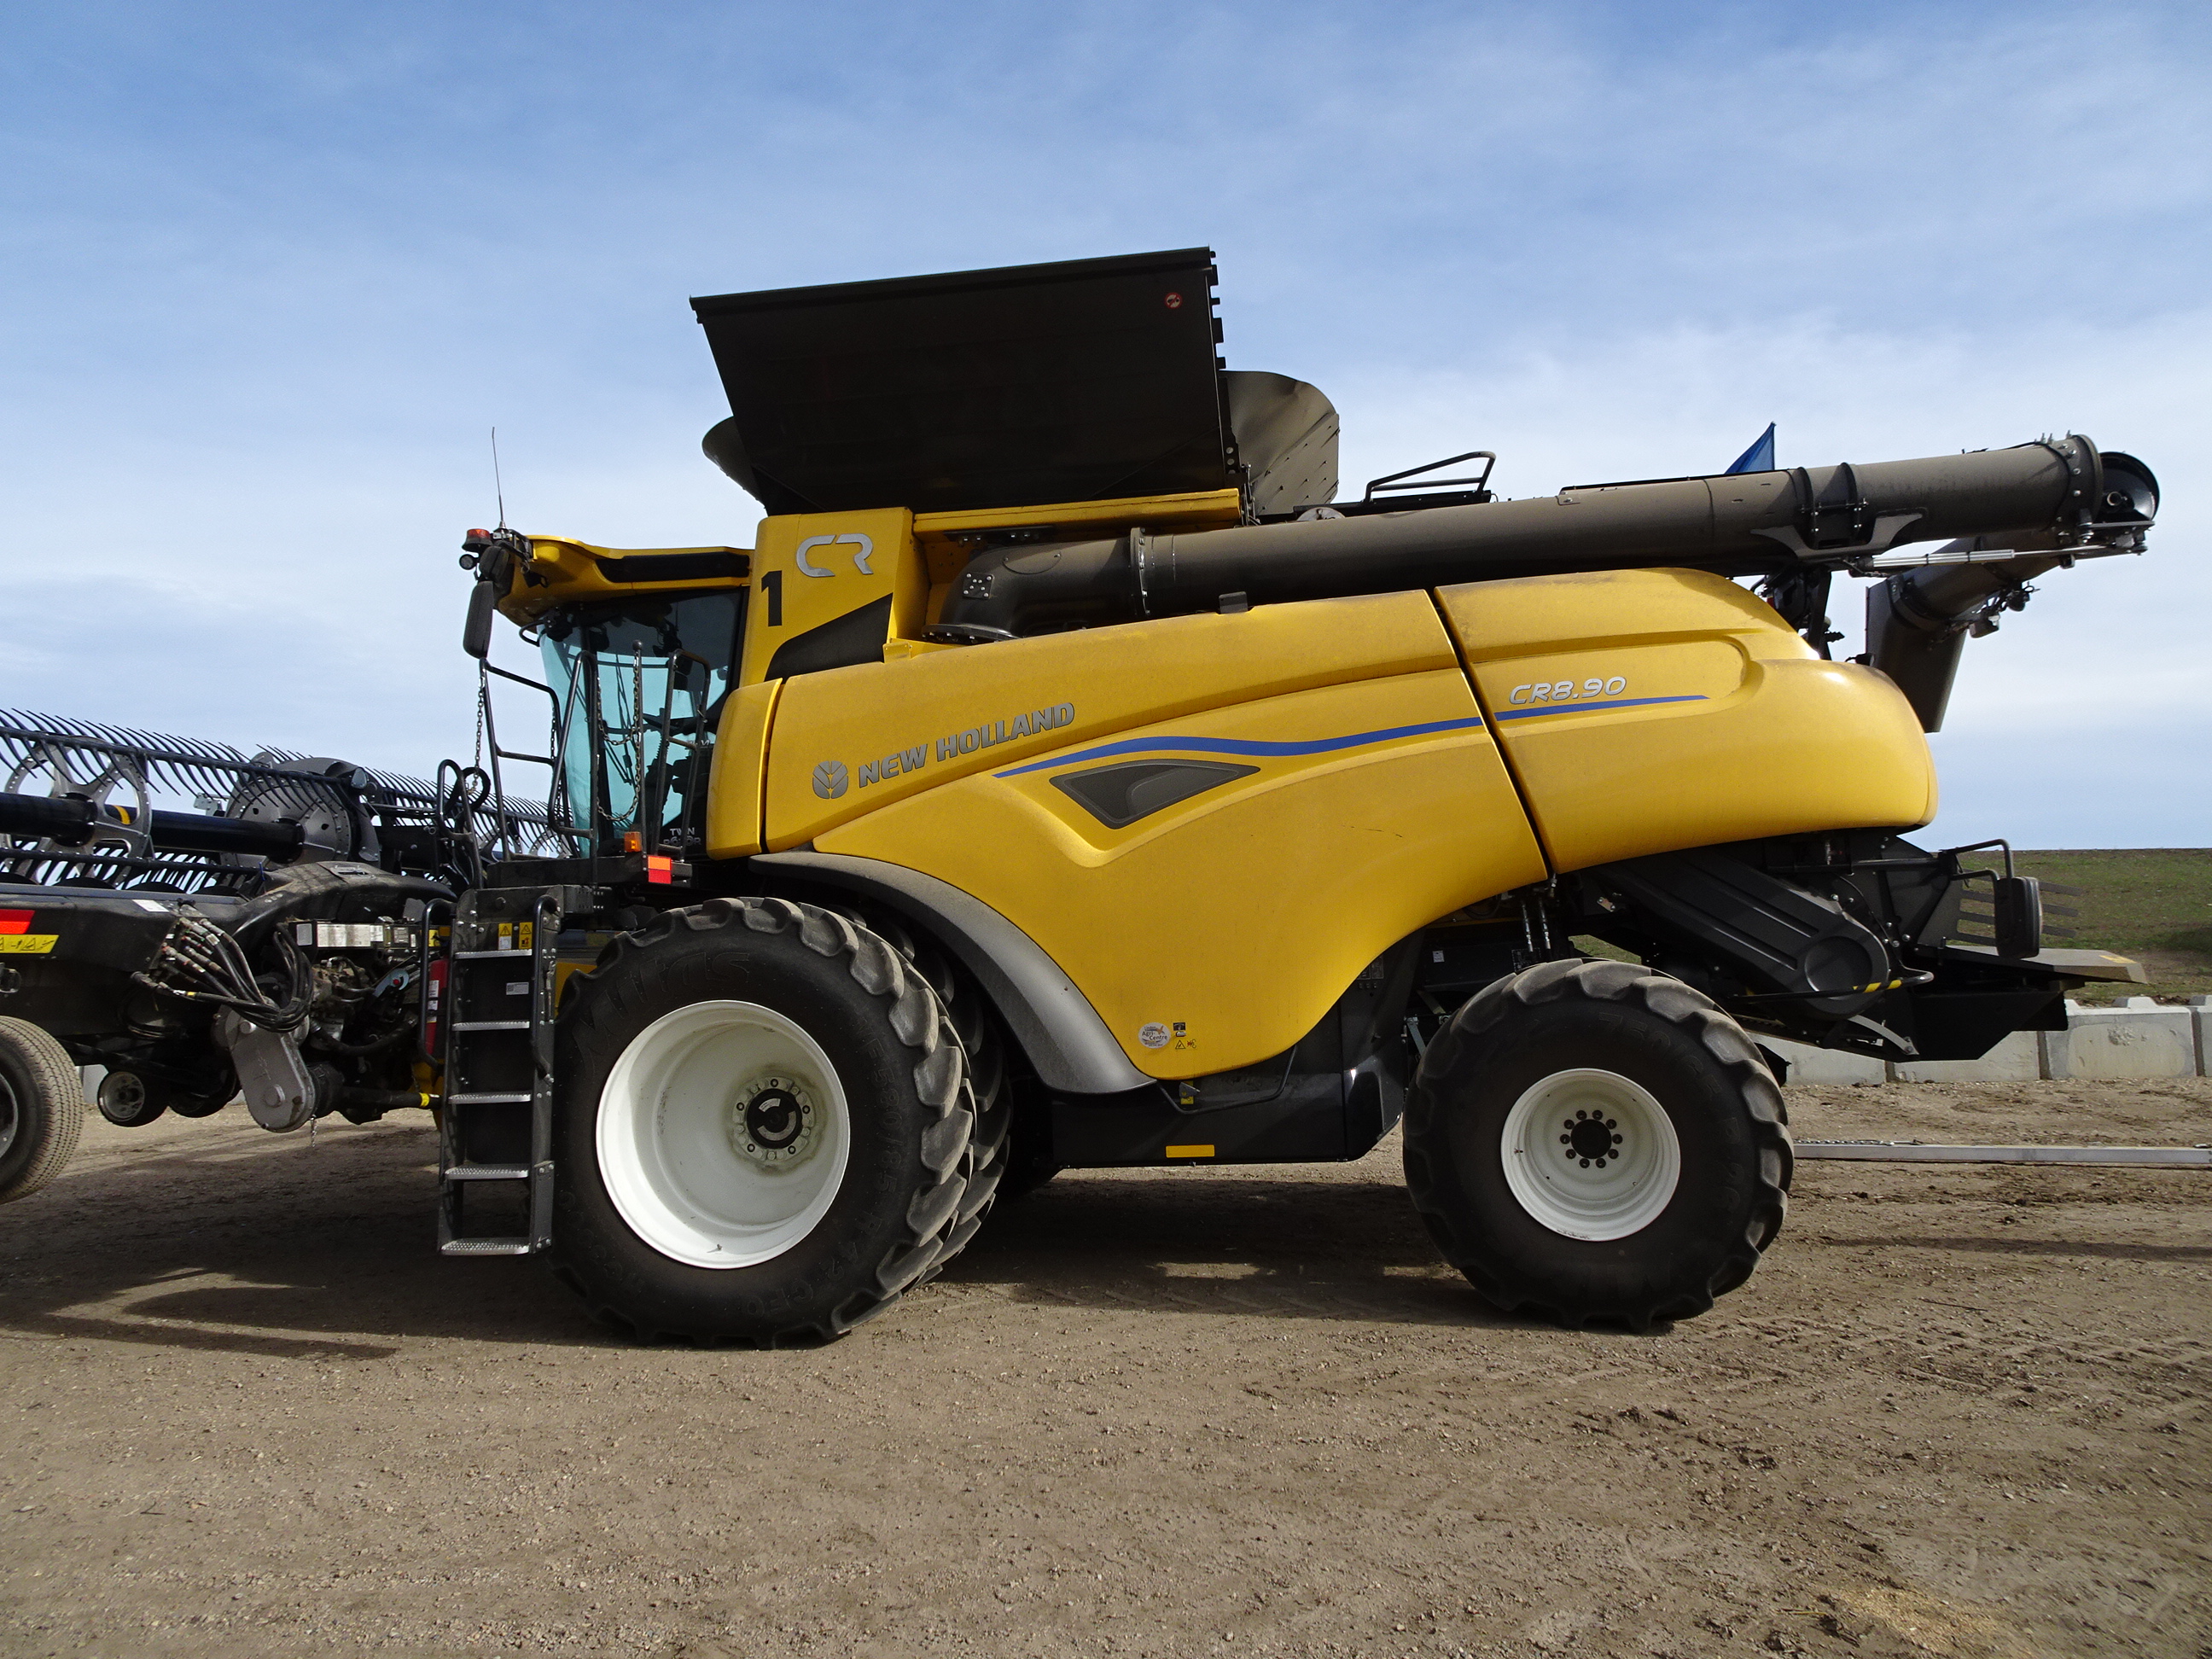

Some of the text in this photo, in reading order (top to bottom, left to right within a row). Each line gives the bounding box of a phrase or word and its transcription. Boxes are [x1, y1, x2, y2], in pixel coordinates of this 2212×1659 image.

[796, 533, 874, 578] CR
[761, 570, 782, 626] 1
[1510, 676, 1627, 704] CR8.90
[859, 702, 1074, 789] NEW HOLLAND
[669, 827, 696, 835] TWN
